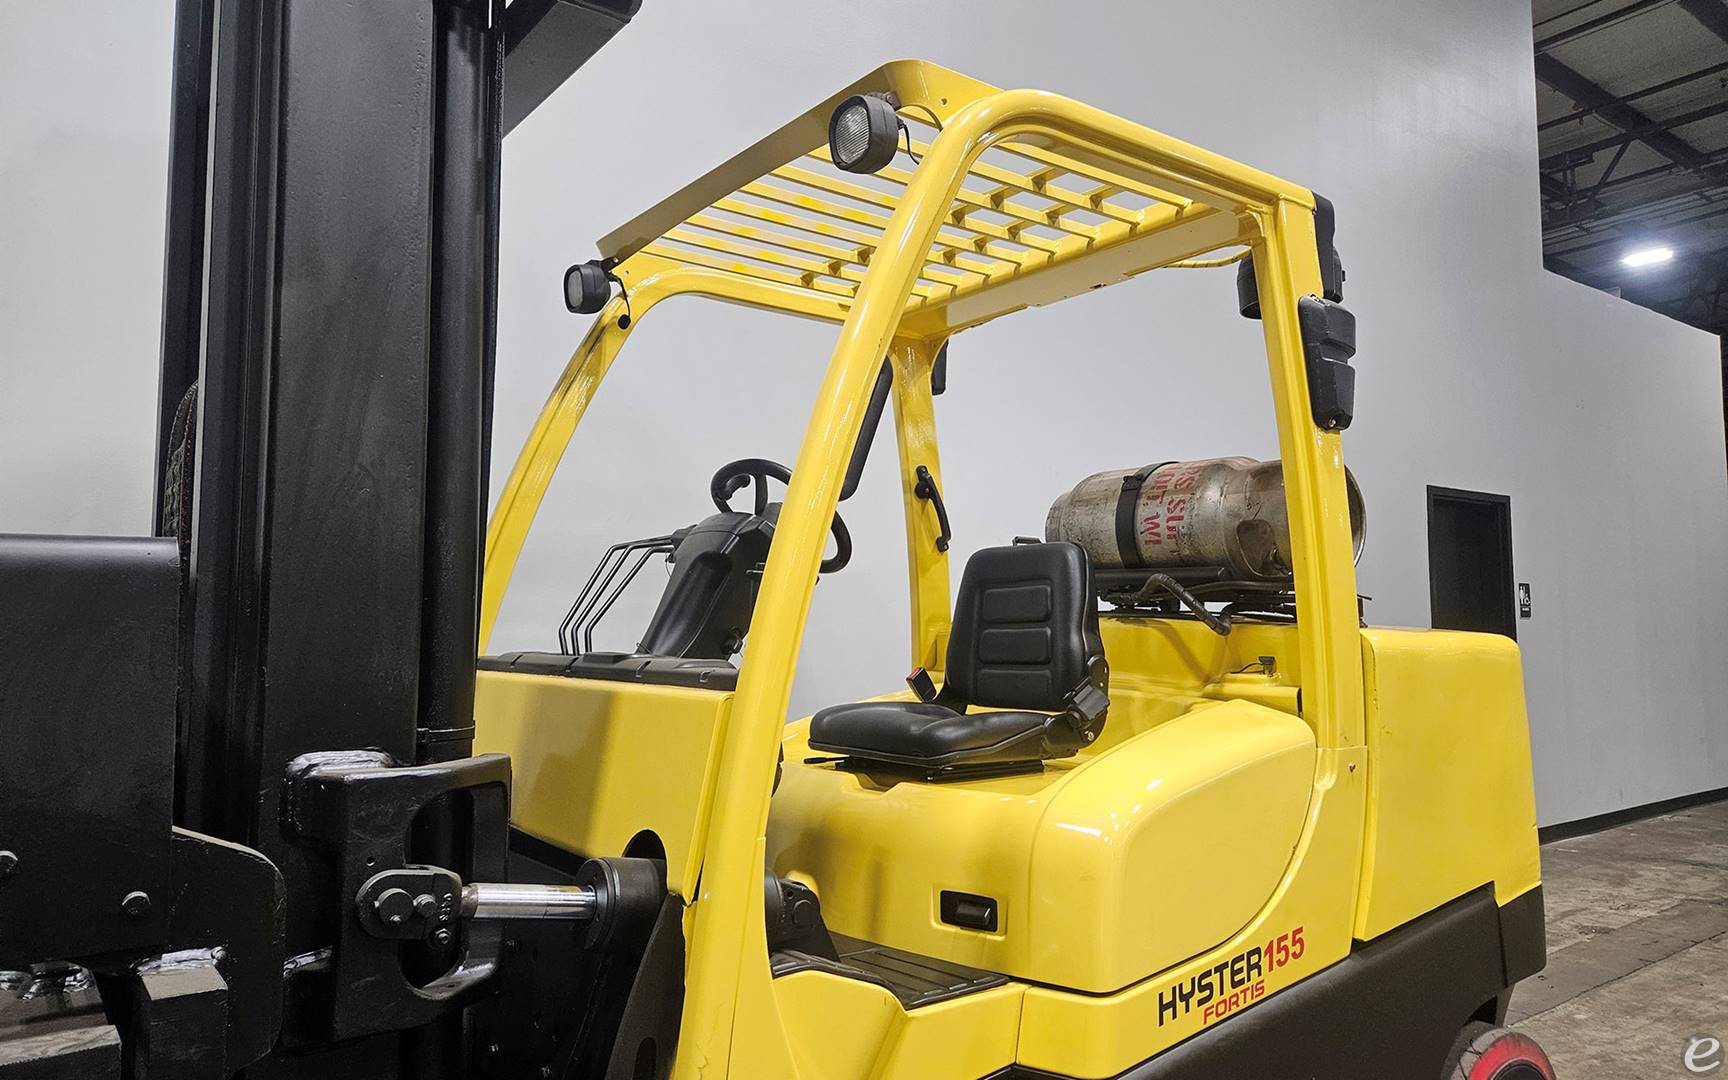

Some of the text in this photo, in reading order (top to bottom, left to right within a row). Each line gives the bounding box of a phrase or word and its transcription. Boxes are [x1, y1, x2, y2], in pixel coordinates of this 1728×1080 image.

[1158, 926, 1305, 1028] HYSTER 155
[1203, 979, 1265, 1025] FORTIS
